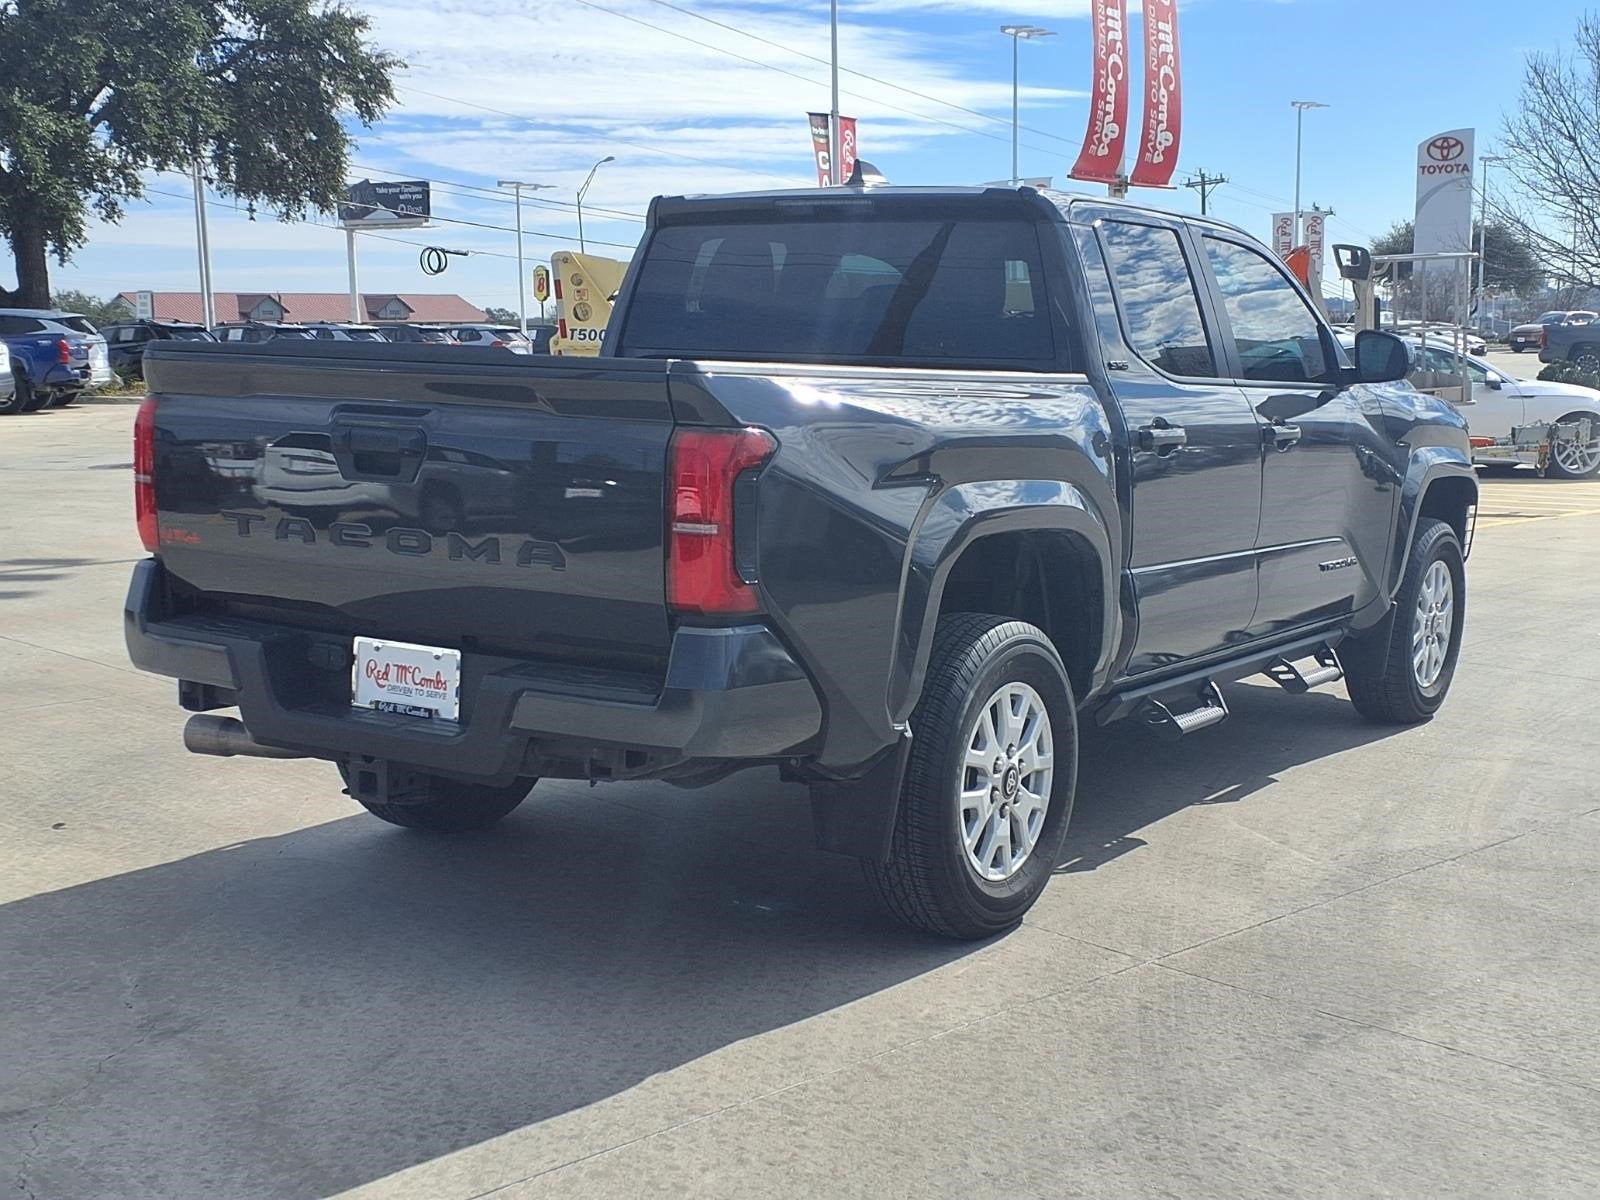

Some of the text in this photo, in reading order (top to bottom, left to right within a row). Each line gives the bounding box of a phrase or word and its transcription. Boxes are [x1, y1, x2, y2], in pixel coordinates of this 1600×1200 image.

[1088, 0, 1106, 156] RIVEN TO SERVE
[1097, 0, 1123, 156] McCombs
[1144, 5, 1158, 163] DRIVEN TO SERVE
[1153, 12, 1175, 163] McCombs
[842, 129, 855, 166] Red
[1420, 163, 1469, 176] TOYOTA
[1276, 217, 1293, 237] Red
[1306, 215, 1323, 236] Red
[537, 277, 545, 293] 8
[221, 510, 567, 572] TACOMA
[1319, 556, 1357, 571] TACOMA
[366, 659, 448, 691] Red McCombs
[386, 684, 448, 701] DRIVEN TO SERVE
